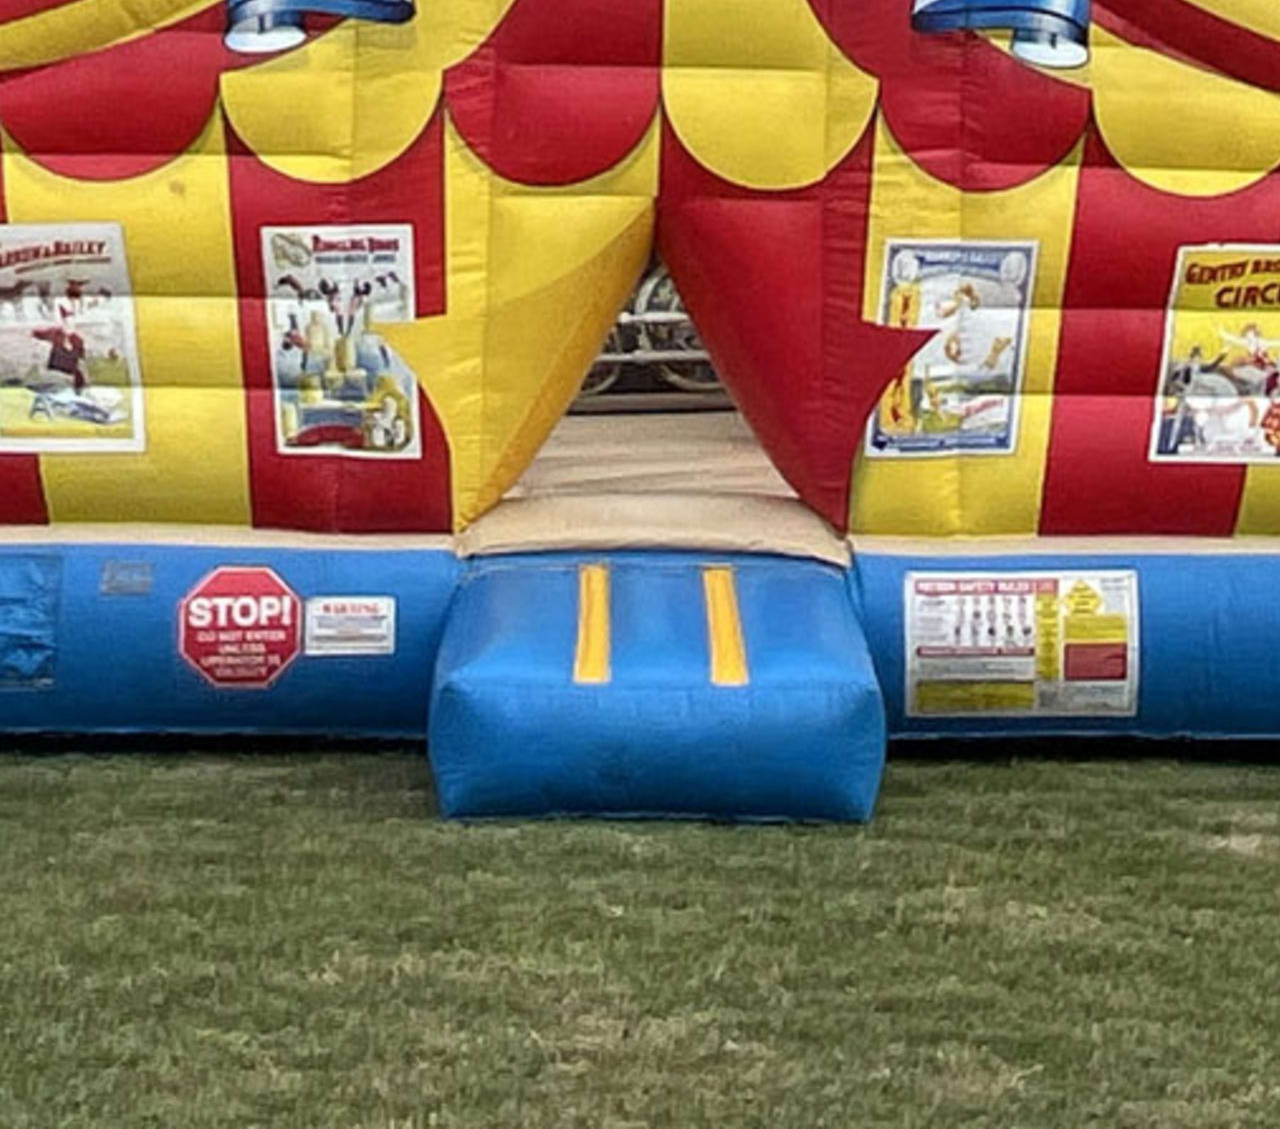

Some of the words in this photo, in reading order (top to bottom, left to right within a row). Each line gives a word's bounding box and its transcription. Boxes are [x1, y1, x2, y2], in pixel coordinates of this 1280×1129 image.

[1185, 259, 1249, 285] GENTRY
[188, 595, 293, 627] STOP!
[196, 630, 217, 642] DO
[219, 630, 243, 641] NOT
[245, 629, 287, 641] ENTER
